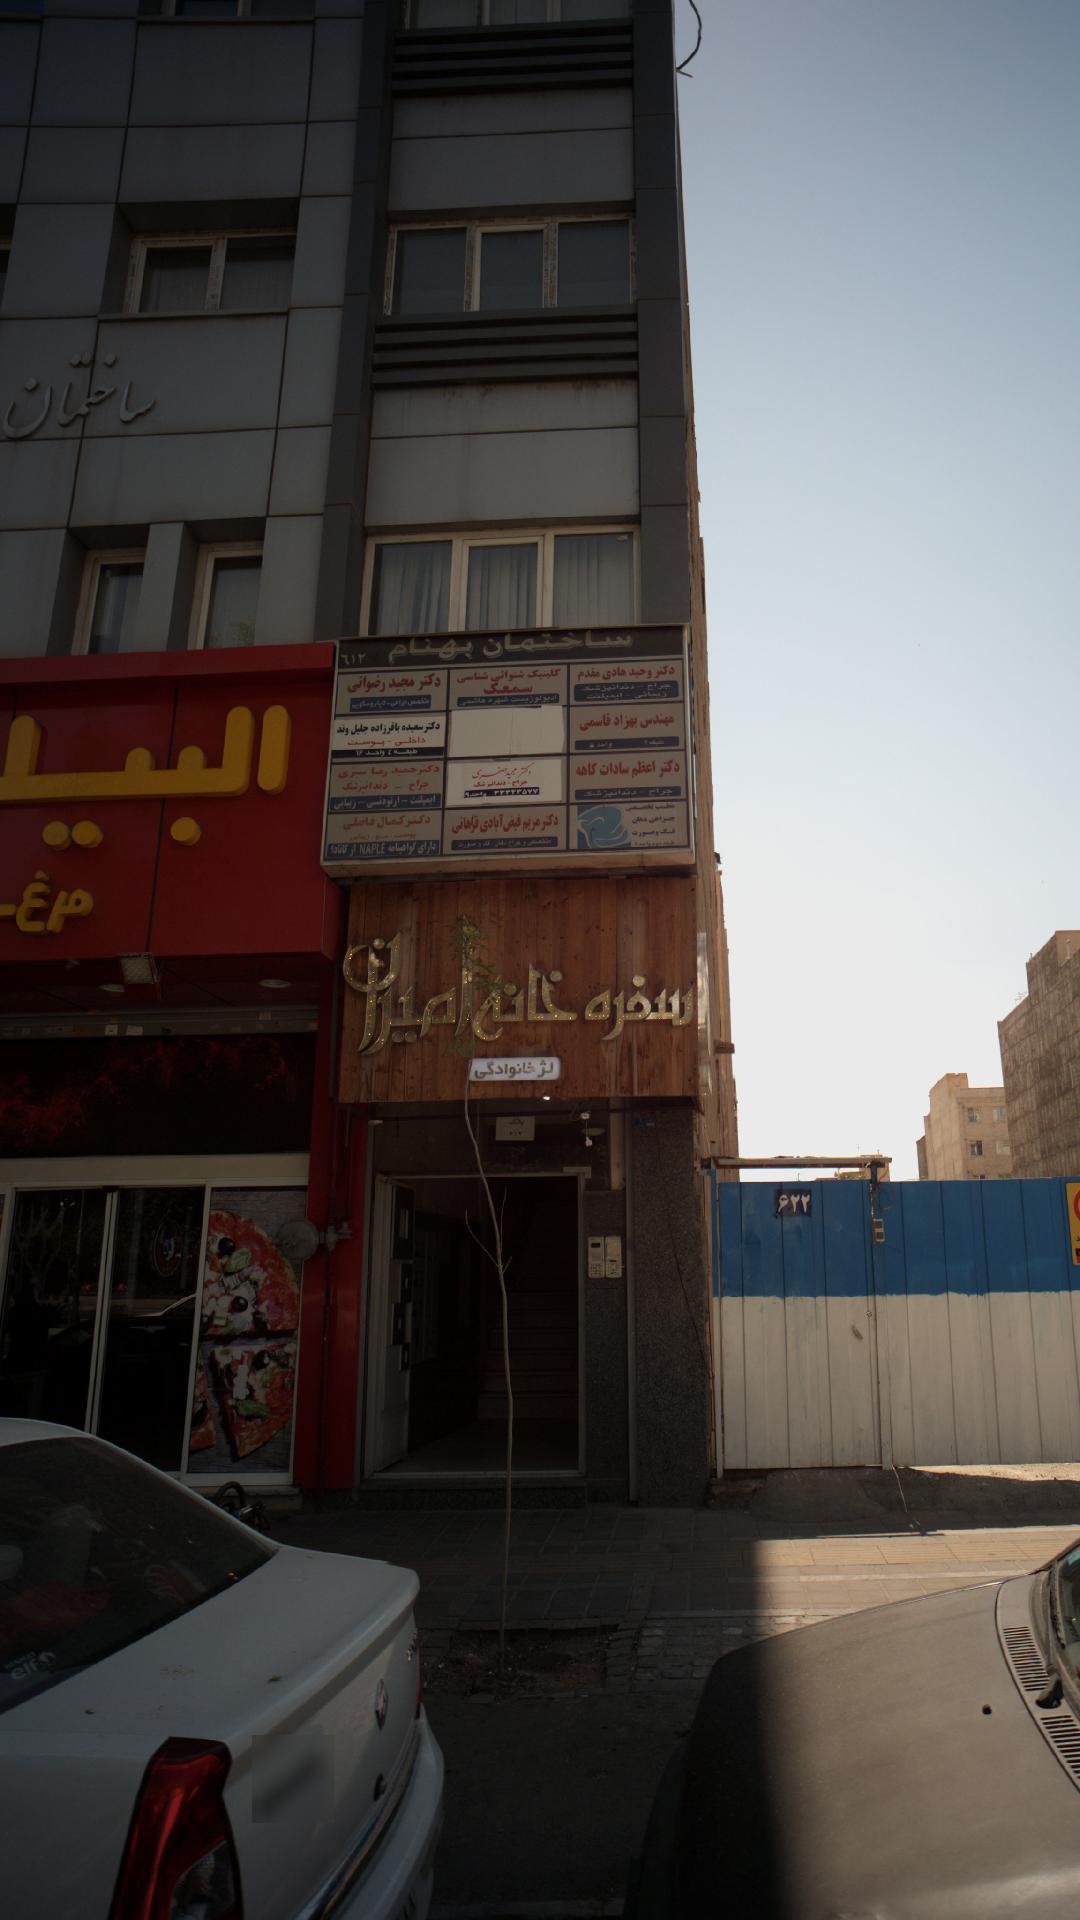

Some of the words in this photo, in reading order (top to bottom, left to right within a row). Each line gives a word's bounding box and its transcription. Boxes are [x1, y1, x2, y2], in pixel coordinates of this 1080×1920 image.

[2, 352, 156, 440] ساختمان
[388, 634, 474, 666] بهنام
[483, 630, 634, 658] ساختمان
[527, 669, 561, 680] کلینیک
[577, 670, 601, 682] مقدم
[602, 666, 627, 681] هادی
[629, 667, 653, 679] وحید
[655, 665, 676, 680] دکتر
[347, 674, 386, 694] رضوانی
[388, 678, 415, 692] مجید
[418, 672, 442, 691] دکتر
[424, 722, 441, 734] دکتر
[579, 713, 612, 732] قاسمی
[613, 714, 638, 731] بهزاد
[639, 713, 675, 729] مهندس
[351, 724, 369, 736] جلیل
[400, 724, 423, 734] سعیده
[347, 740, 385, 749] پوست
[394, 737, 427, 748] داخلی
[419, 765, 440, 776] دکتر
[600, 762, 631, 776] سادات
[631, 761, 656, 778] اعظم
[658, 760, 680, 777] دکتر
[408, 780, 429, 791] جراح
[649, 788, 673, 797] جراح
[376, 816, 406, 829] کمال
[405, 815, 431, 827] دکتر
[522, 818, 540, 833] مریم
[540, 814, 559, 831] دکتر
[15, 869, 94, 933] مرغ
[584, 974, 695, 1041] سفره
[474, 1061, 535, 1079] خانوادگی
[537, 1059, 554, 1078] لژ
